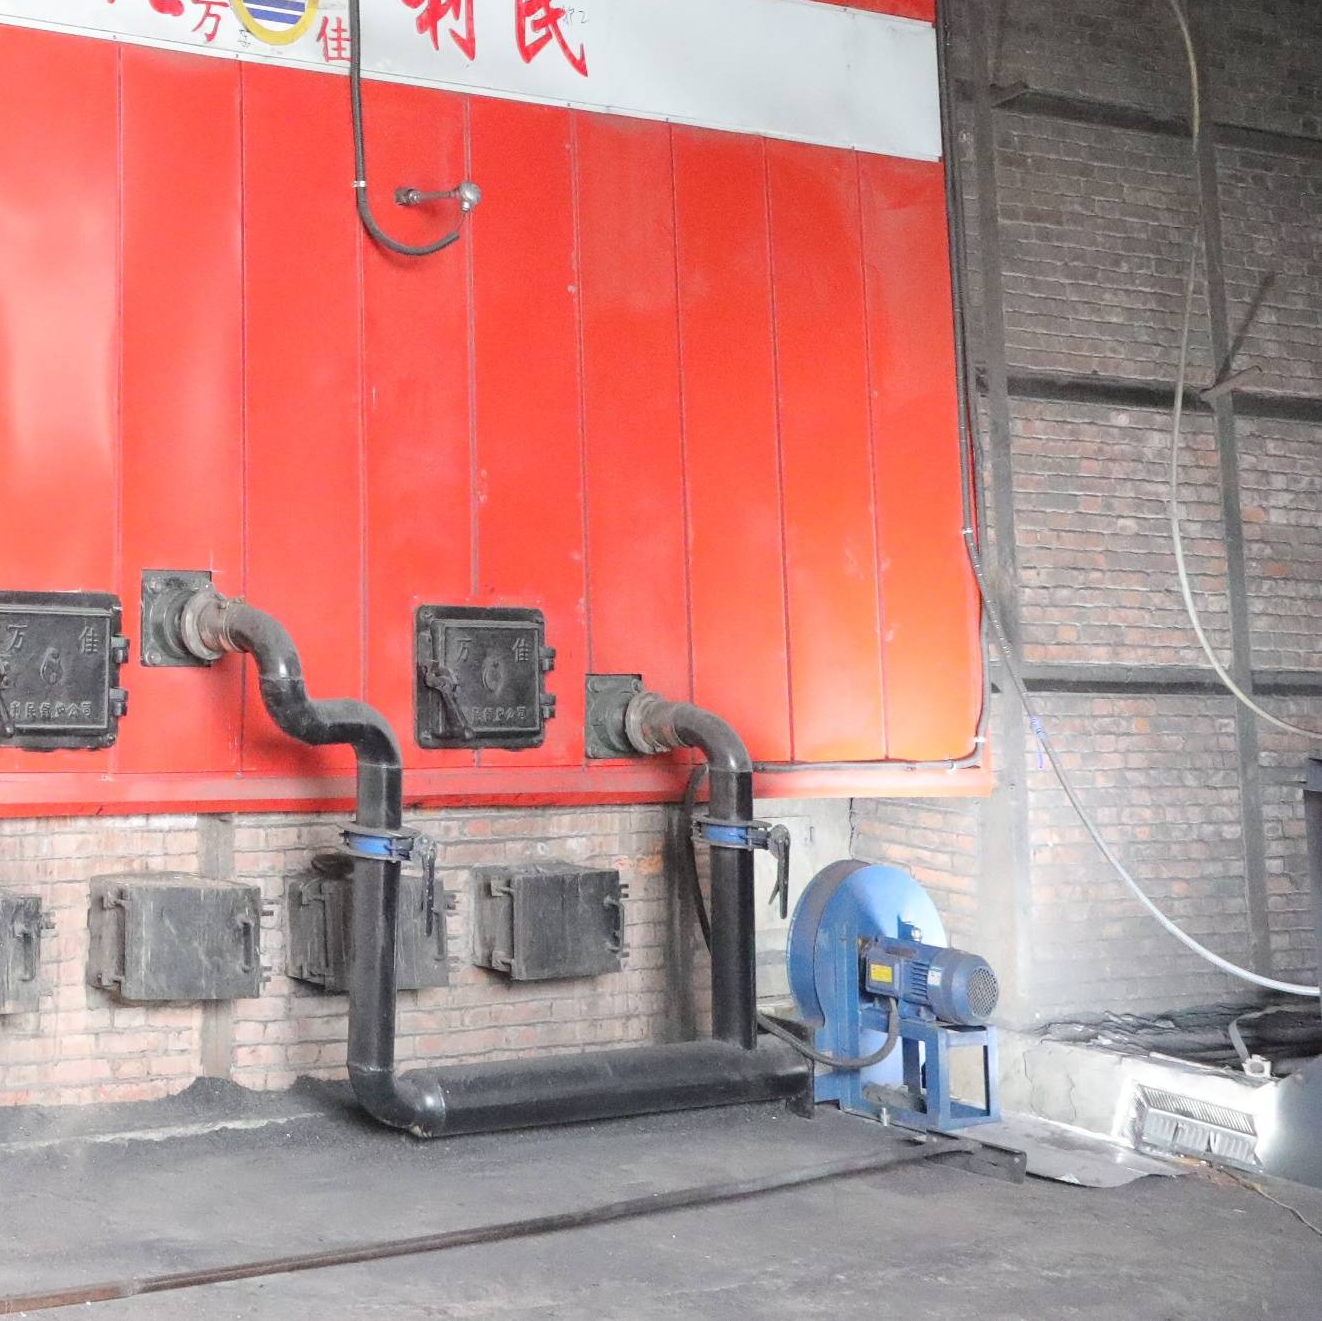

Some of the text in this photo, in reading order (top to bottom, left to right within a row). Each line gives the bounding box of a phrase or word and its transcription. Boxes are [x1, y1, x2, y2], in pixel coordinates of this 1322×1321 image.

[315, 15, 351, 63] 佳
[5, 623, 100, 655] 万 佳
[455, 636, 530, 663] 万 佳
